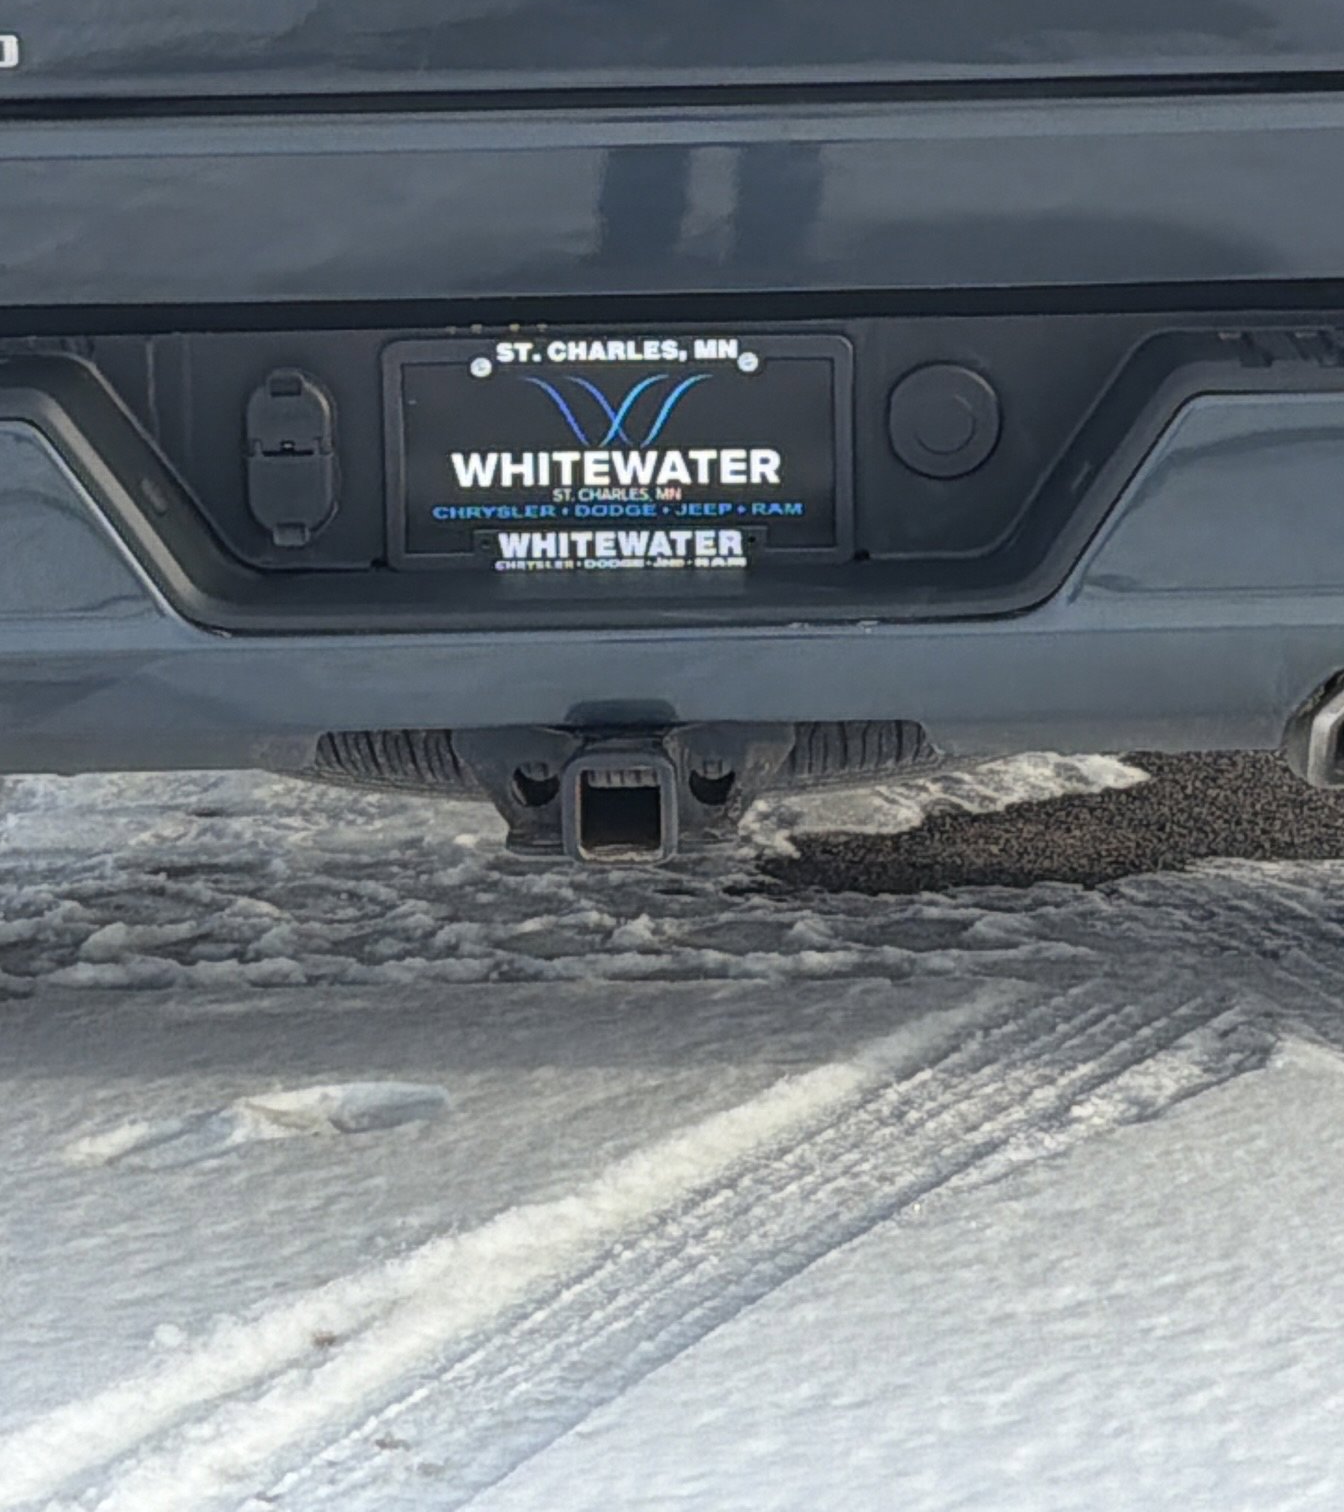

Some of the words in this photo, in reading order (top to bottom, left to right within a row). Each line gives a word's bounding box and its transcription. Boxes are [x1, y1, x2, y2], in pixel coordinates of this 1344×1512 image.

[496, 342, 542, 363] ST.
[547, 339, 688, 362] CHARLES,
[694, 339, 739, 359] MN
[451, 449, 781, 487] WHITEWATER
[552, 488, 575, 502] ST.
[656, 487, 682, 500] MN
[432, 505, 556, 520] CHRYSLER
[574, 503, 657, 518] DODGE
[674, 502, 733, 516] JEEP
[751, 502, 804, 515] RAM
[498, 529, 743, 559] WHITEWATER
